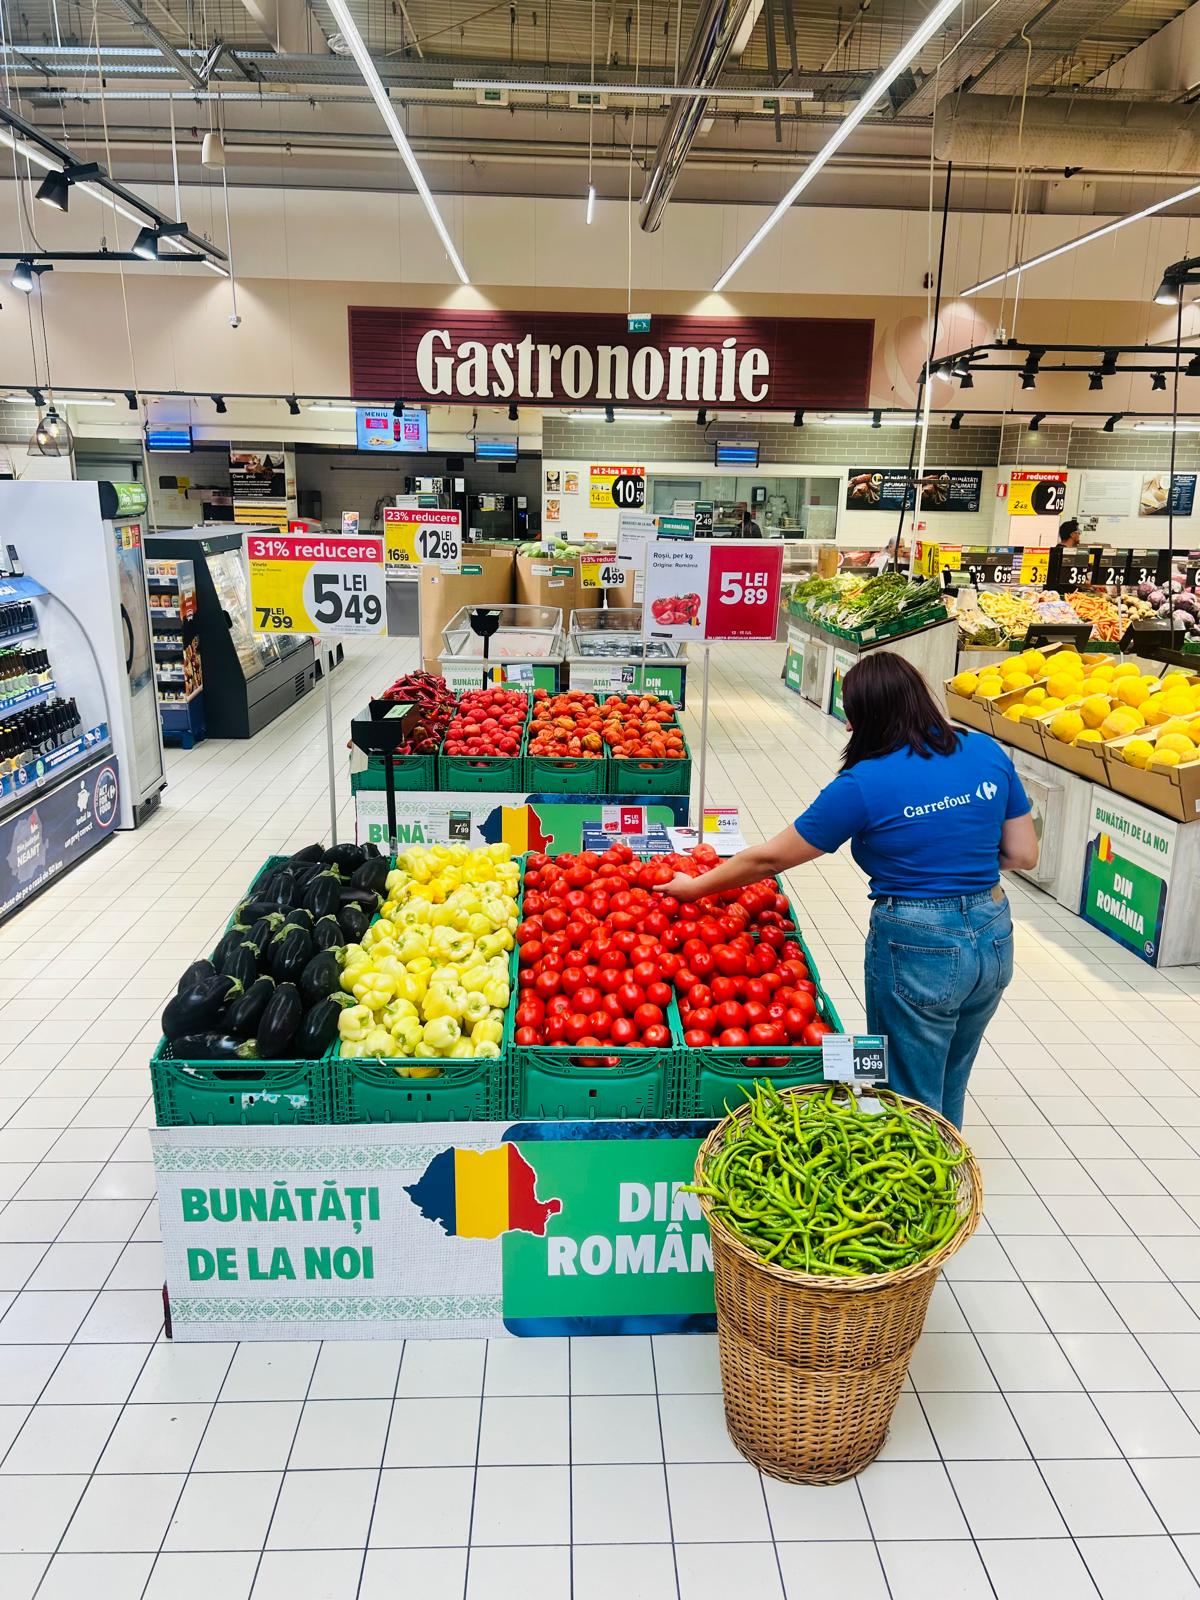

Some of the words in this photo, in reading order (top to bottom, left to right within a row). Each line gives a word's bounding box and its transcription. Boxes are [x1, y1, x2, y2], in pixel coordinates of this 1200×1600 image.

[416, 329, 770, 403] Gastronomie
[616, 480, 634, 502] 10
[636, 492, 644, 502] 50
[1046, 486, 1056, 510] 2
[1056, 498, 1064, 510] 09
[386, 511, 408, 520] 23%
[412, 512, 456, 522] reducere
[696, 514, 702, 525] 2
[442, 530, 452, 540] LEI
[253, 541, 290, 557] 31%
[294, 542, 376, 559] reducere
[418, 530, 441, 558] 12
[442, 542, 458, 559] 99
[388, 548, 400, 561] 16
[344, 574, 367, 591] LEI
[602, 567, 612, 583] 4
[611, 573, 624, 583] 99
[745, 572, 768, 586] LEI
[994, 566, 1002, 582] 6
[1002, 573, 1011, 582] 99
[1030, 567, 1038, 582] 3
[1069, 567, 1078, 583] 3
[1106, 568, 1114, 584] 2
[720, 572, 743, 605] 5
[744, 588, 768, 605] 89
[313, 574, 342, 624] 5
[256, 607, 271, 628] 7
[272, 616, 292, 628] 99
[344, 595, 382, 624] 49
[622, 672, 628, 681] 7
[646, 678, 661, 687] DIN
[904, 793, 971, 818] Carrefour
[624, 814, 632, 825] 5
[454, 824, 462, 833] 7
[1096, 808, 1130, 838] BUNĂTĂȚI
[1131, 824, 1142, 840] DE
[1142, 830, 1152, 846] LA
[1153, 836, 1168, 854] NOI
[1113, 873, 1133, 899] DIN
[1096, 890, 1144, 935] ROMÂNIA
[854, 1057, 870, 1070] 19
[871, 1061, 883, 1069] 99
[182, 1180, 380, 1235] BUNĂTĂȚI
[619, 1182, 702, 1222] DIN
[548, 1222, 714, 1276] ROMÂN
[186, 1248, 238, 1281] DE
[247, 1246, 296, 1280] LA
[304, 1246, 374, 1280] NOI
